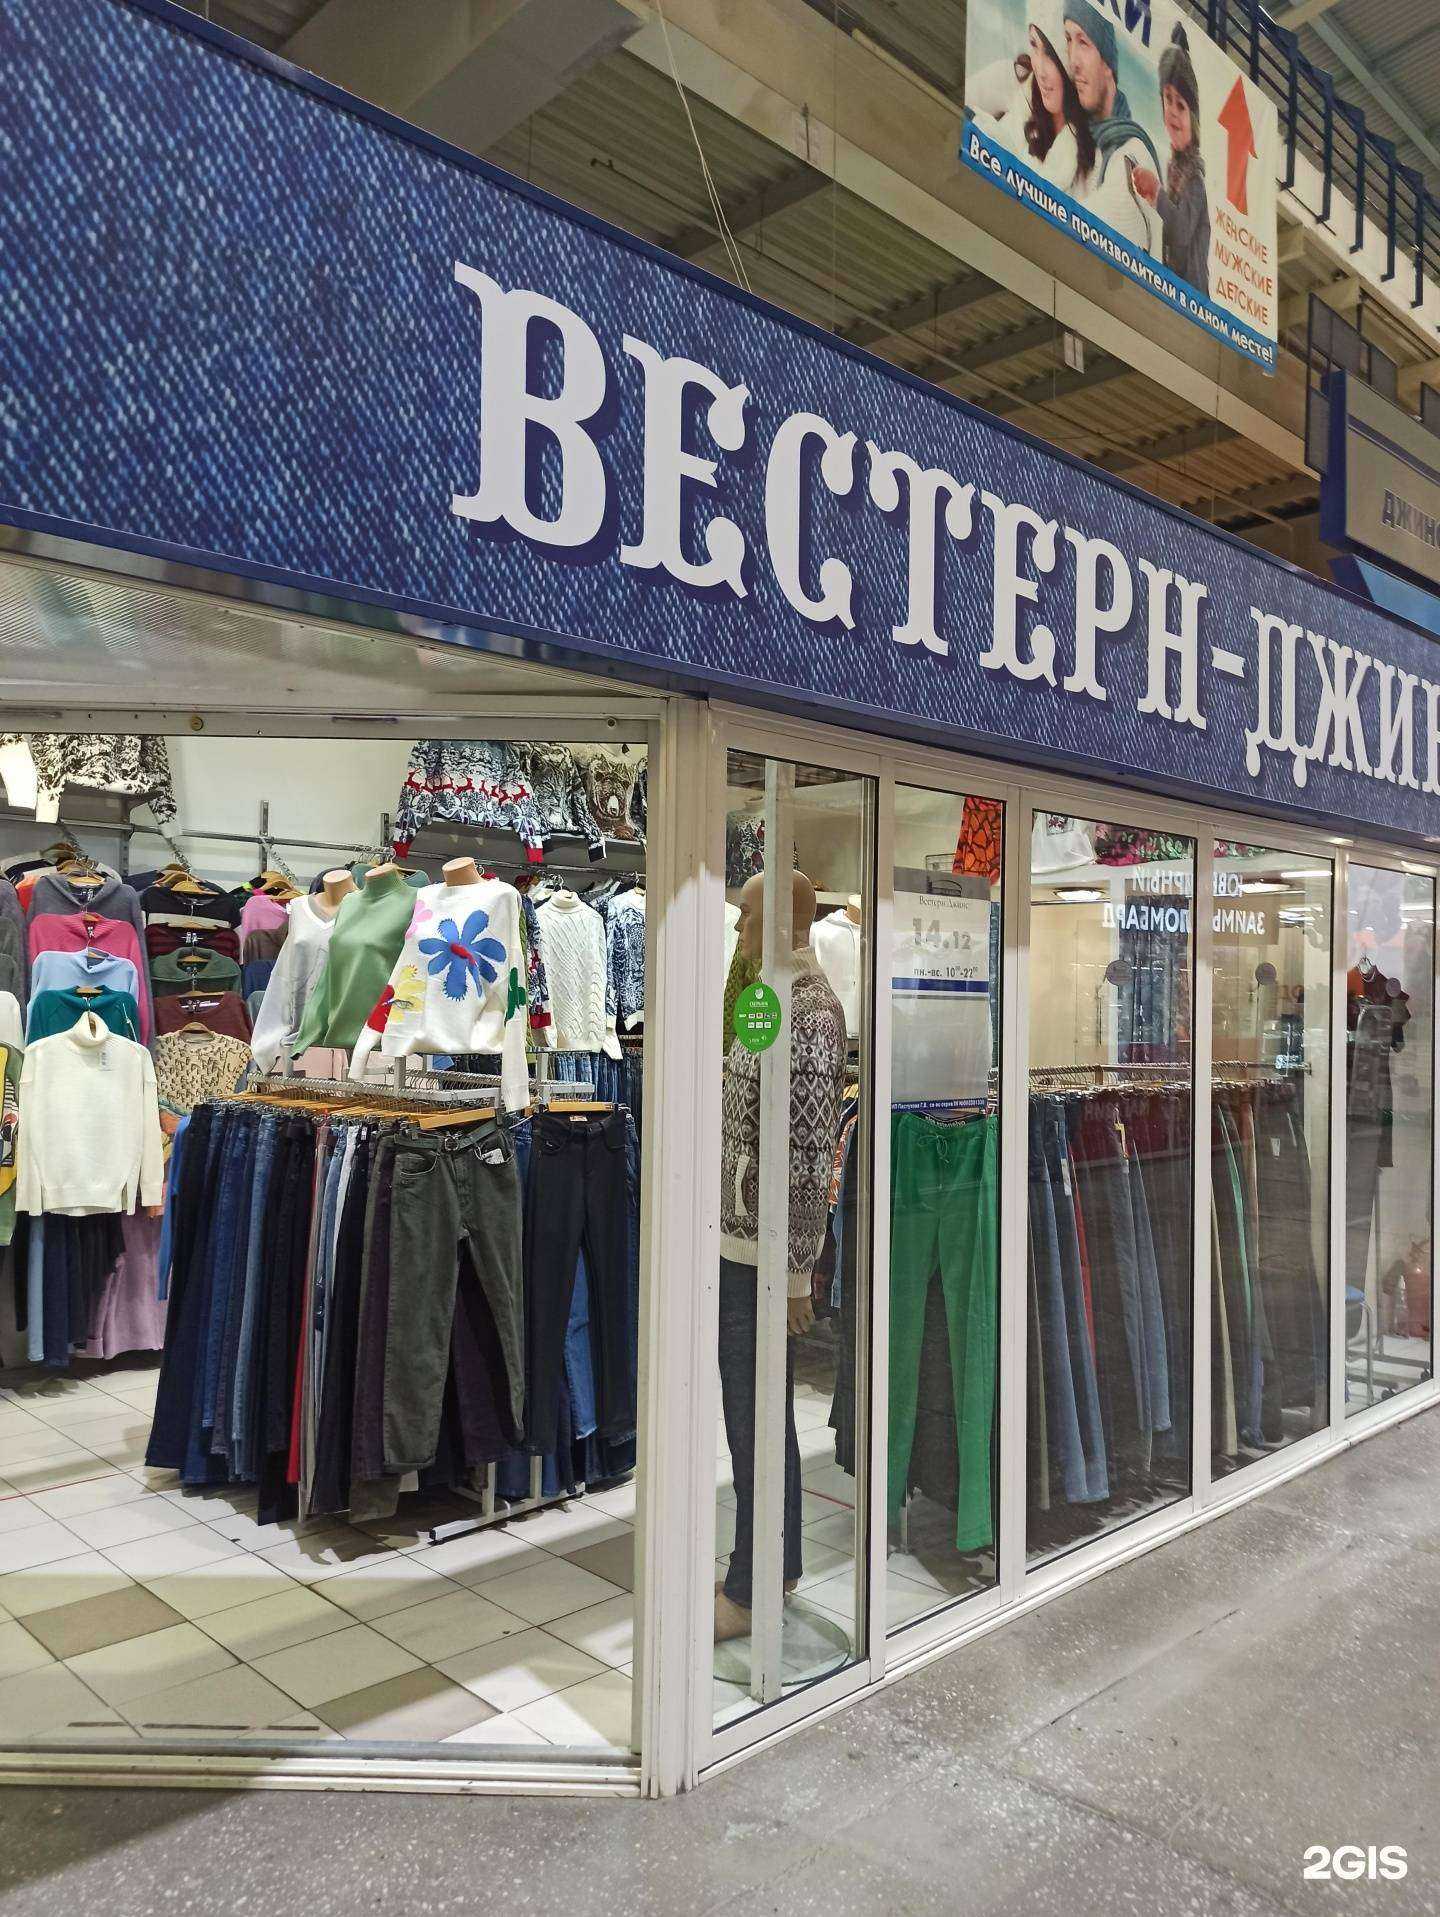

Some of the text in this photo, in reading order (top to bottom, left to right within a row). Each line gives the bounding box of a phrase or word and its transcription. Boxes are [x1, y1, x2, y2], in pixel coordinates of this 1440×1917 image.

[969, 133, 1273, 365] Все лучшие производители в одном месте!
[1215, 206, 1268, 264] ЖЕНСКИЕ
[1214, 238, 1273, 297] МУЖСКИЕ
[1216, 276, 1268, 325] ДЕТСКИЕ
